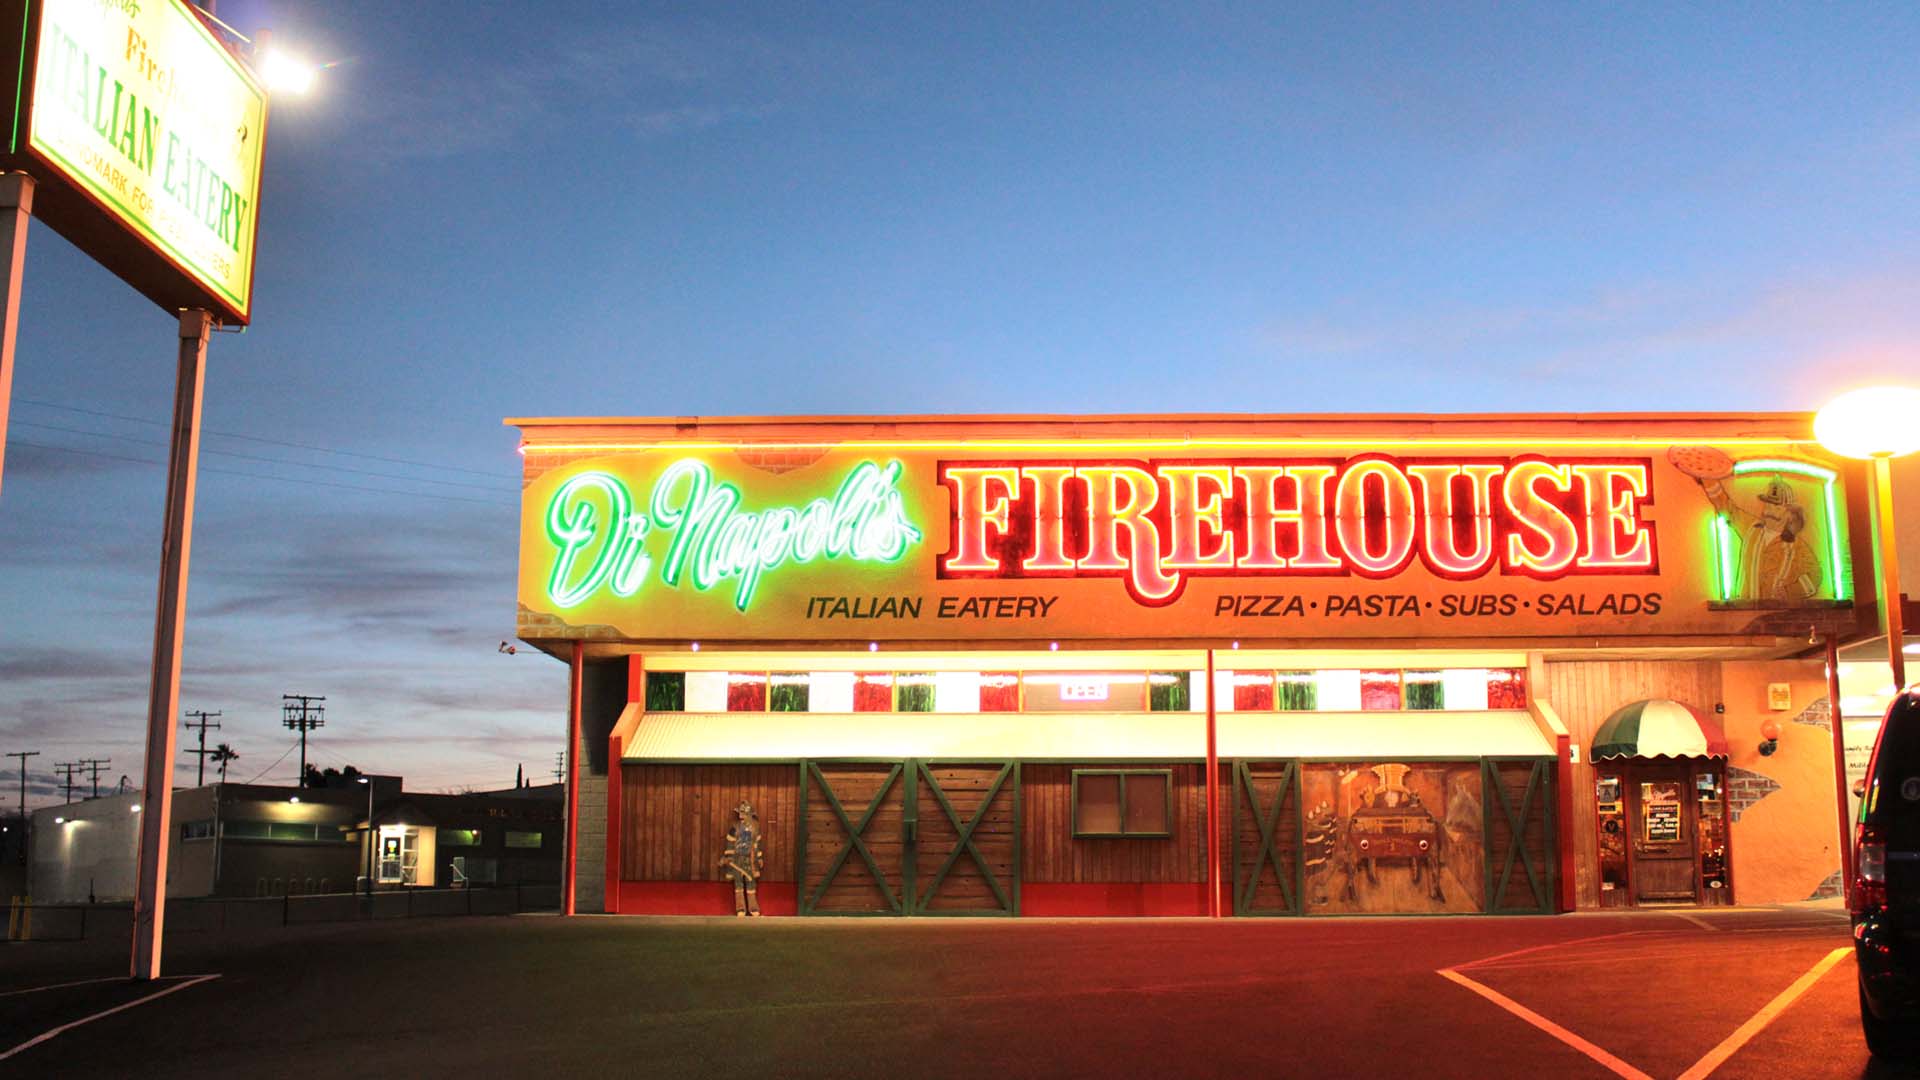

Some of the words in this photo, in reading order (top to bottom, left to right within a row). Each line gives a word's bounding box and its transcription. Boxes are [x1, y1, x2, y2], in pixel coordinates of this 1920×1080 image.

[46, 22, 159, 176] ITALIAN
[162, 130, 248, 253] EATERY
[548, 472, 651, 607] Di
[651, 457, 921, 612] Napoli's
[939, 455, 1658, 604] FIREHOUSE
[806, 597, 922, 619] ITALIAN
[937, 597, 1057, 619] EATERY
[1215, 595, 1306, 617] PIZZA
[1325, 595, 1421, 617] PASTA
[1439, 594, 1517, 616] SUBS
[1536, 593, 1662, 616] SALADS
